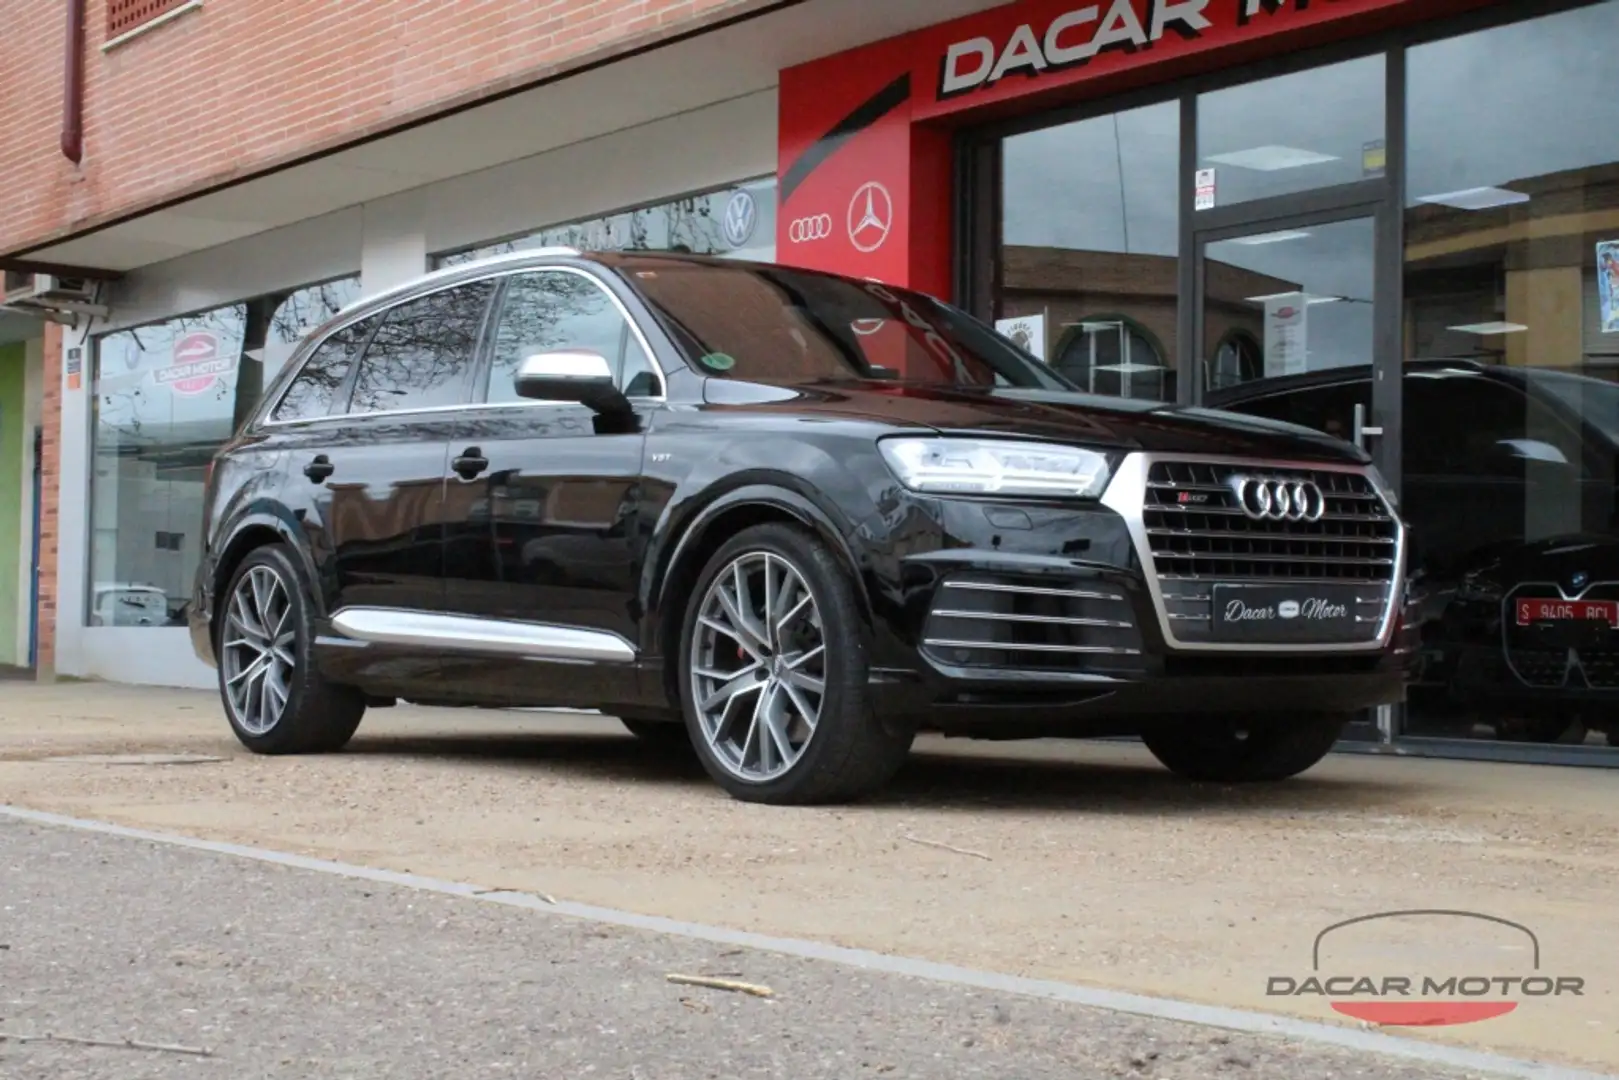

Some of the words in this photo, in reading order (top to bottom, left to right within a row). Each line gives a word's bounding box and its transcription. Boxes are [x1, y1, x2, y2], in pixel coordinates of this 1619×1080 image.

[942, 0, 1213, 93] DACAR
[1224, 599, 1276, 622] Dacar
[1301, 597, 1347, 620] Motor
